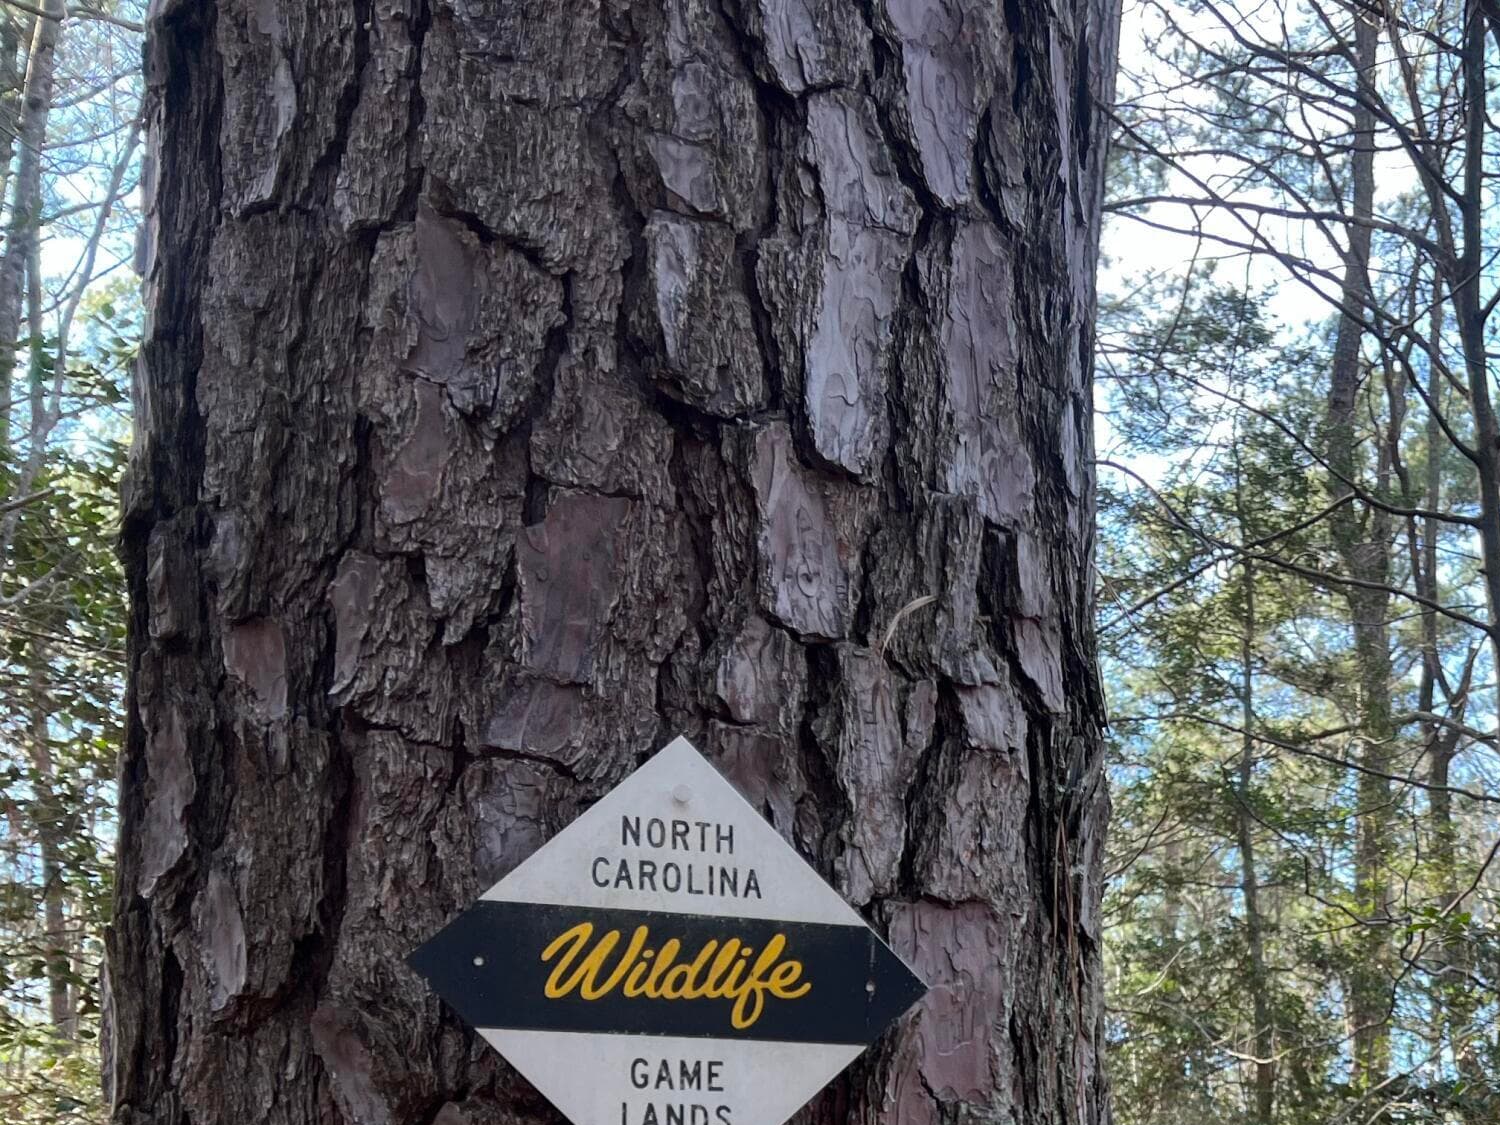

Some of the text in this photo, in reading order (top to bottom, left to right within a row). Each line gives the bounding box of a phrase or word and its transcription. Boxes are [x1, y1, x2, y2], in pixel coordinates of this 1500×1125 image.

[621, 816, 734, 854] NORTH
[591, 857, 762, 899] CAROLINA
[540, 922, 811, 1029] Wildlife
[630, 1058, 724, 1092] GAME
